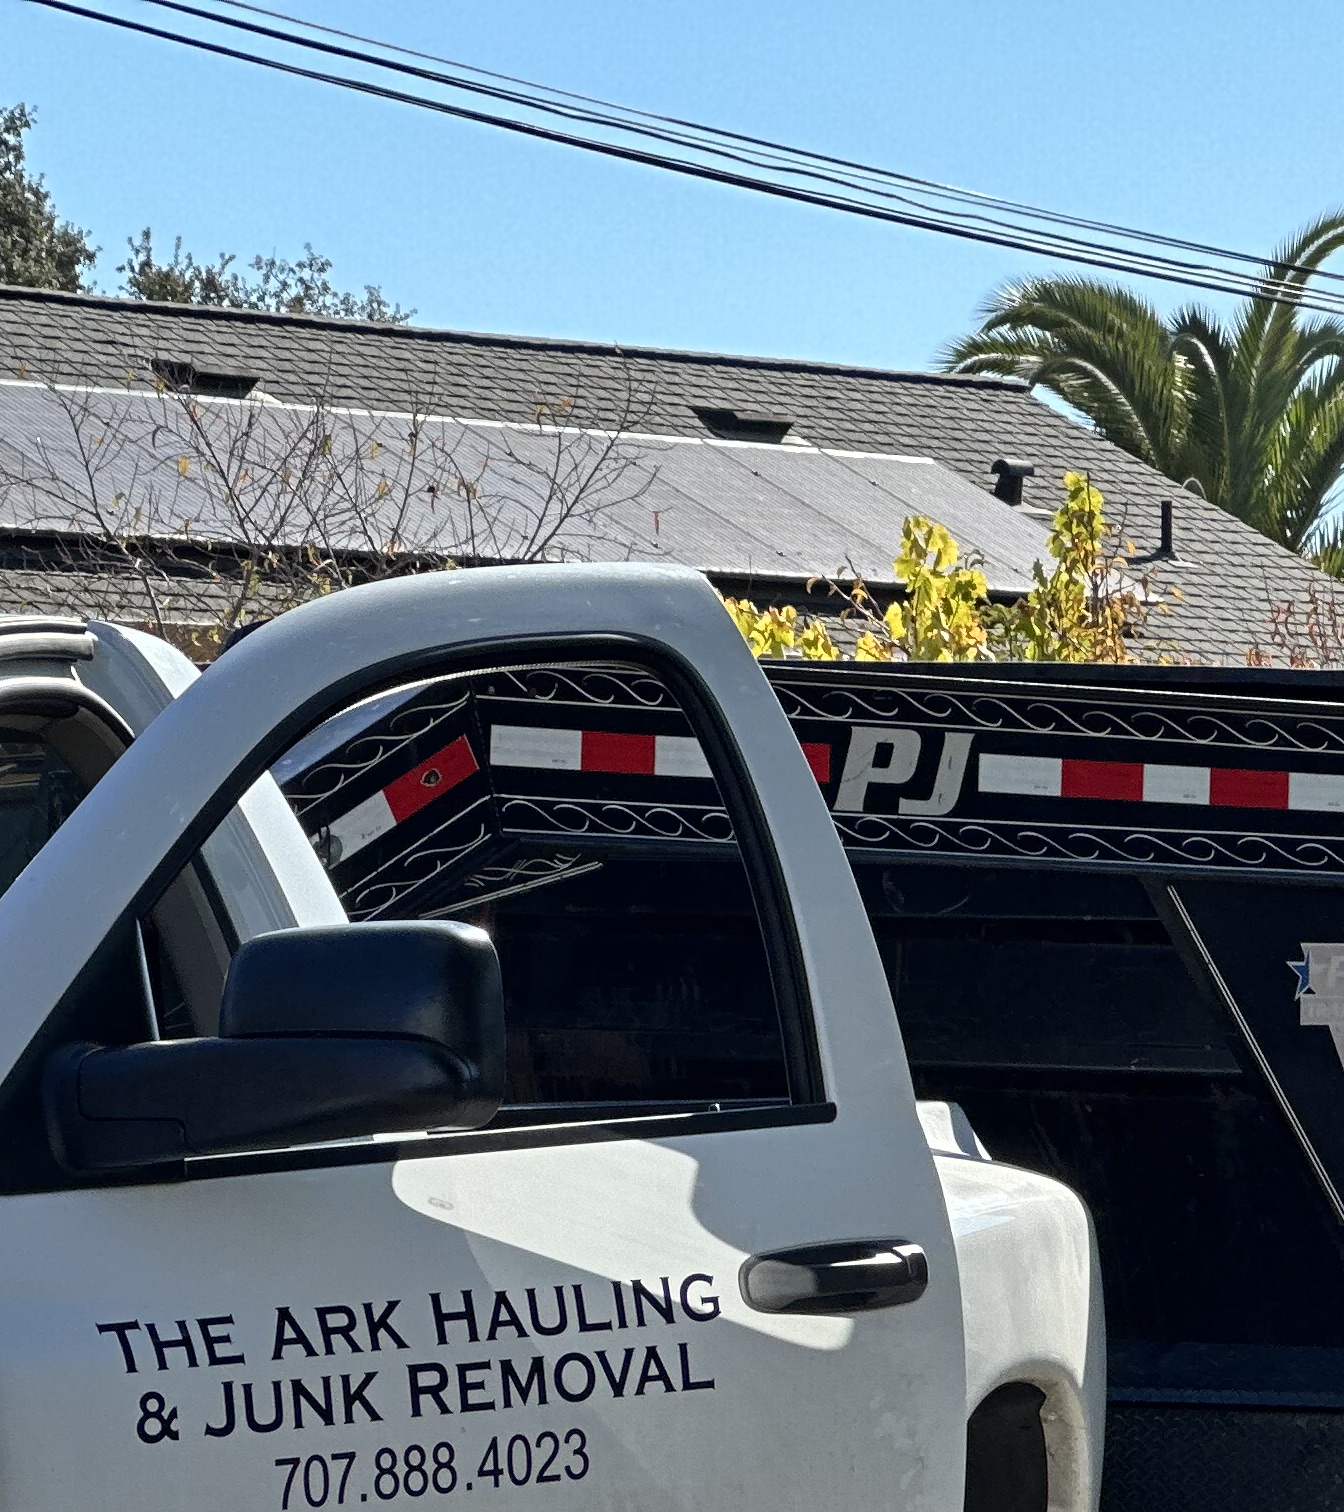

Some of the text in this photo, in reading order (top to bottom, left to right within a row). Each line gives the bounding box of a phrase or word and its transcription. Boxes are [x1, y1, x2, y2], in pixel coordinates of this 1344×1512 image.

[833, 726, 975, 816] PJ
[95, 1273, 722, 1374] THE ARK HAULING
[135, 1343, 717, 1443] & JUNK REMOVAL
[274, 1428, 591, 1511] 707.888.4023
